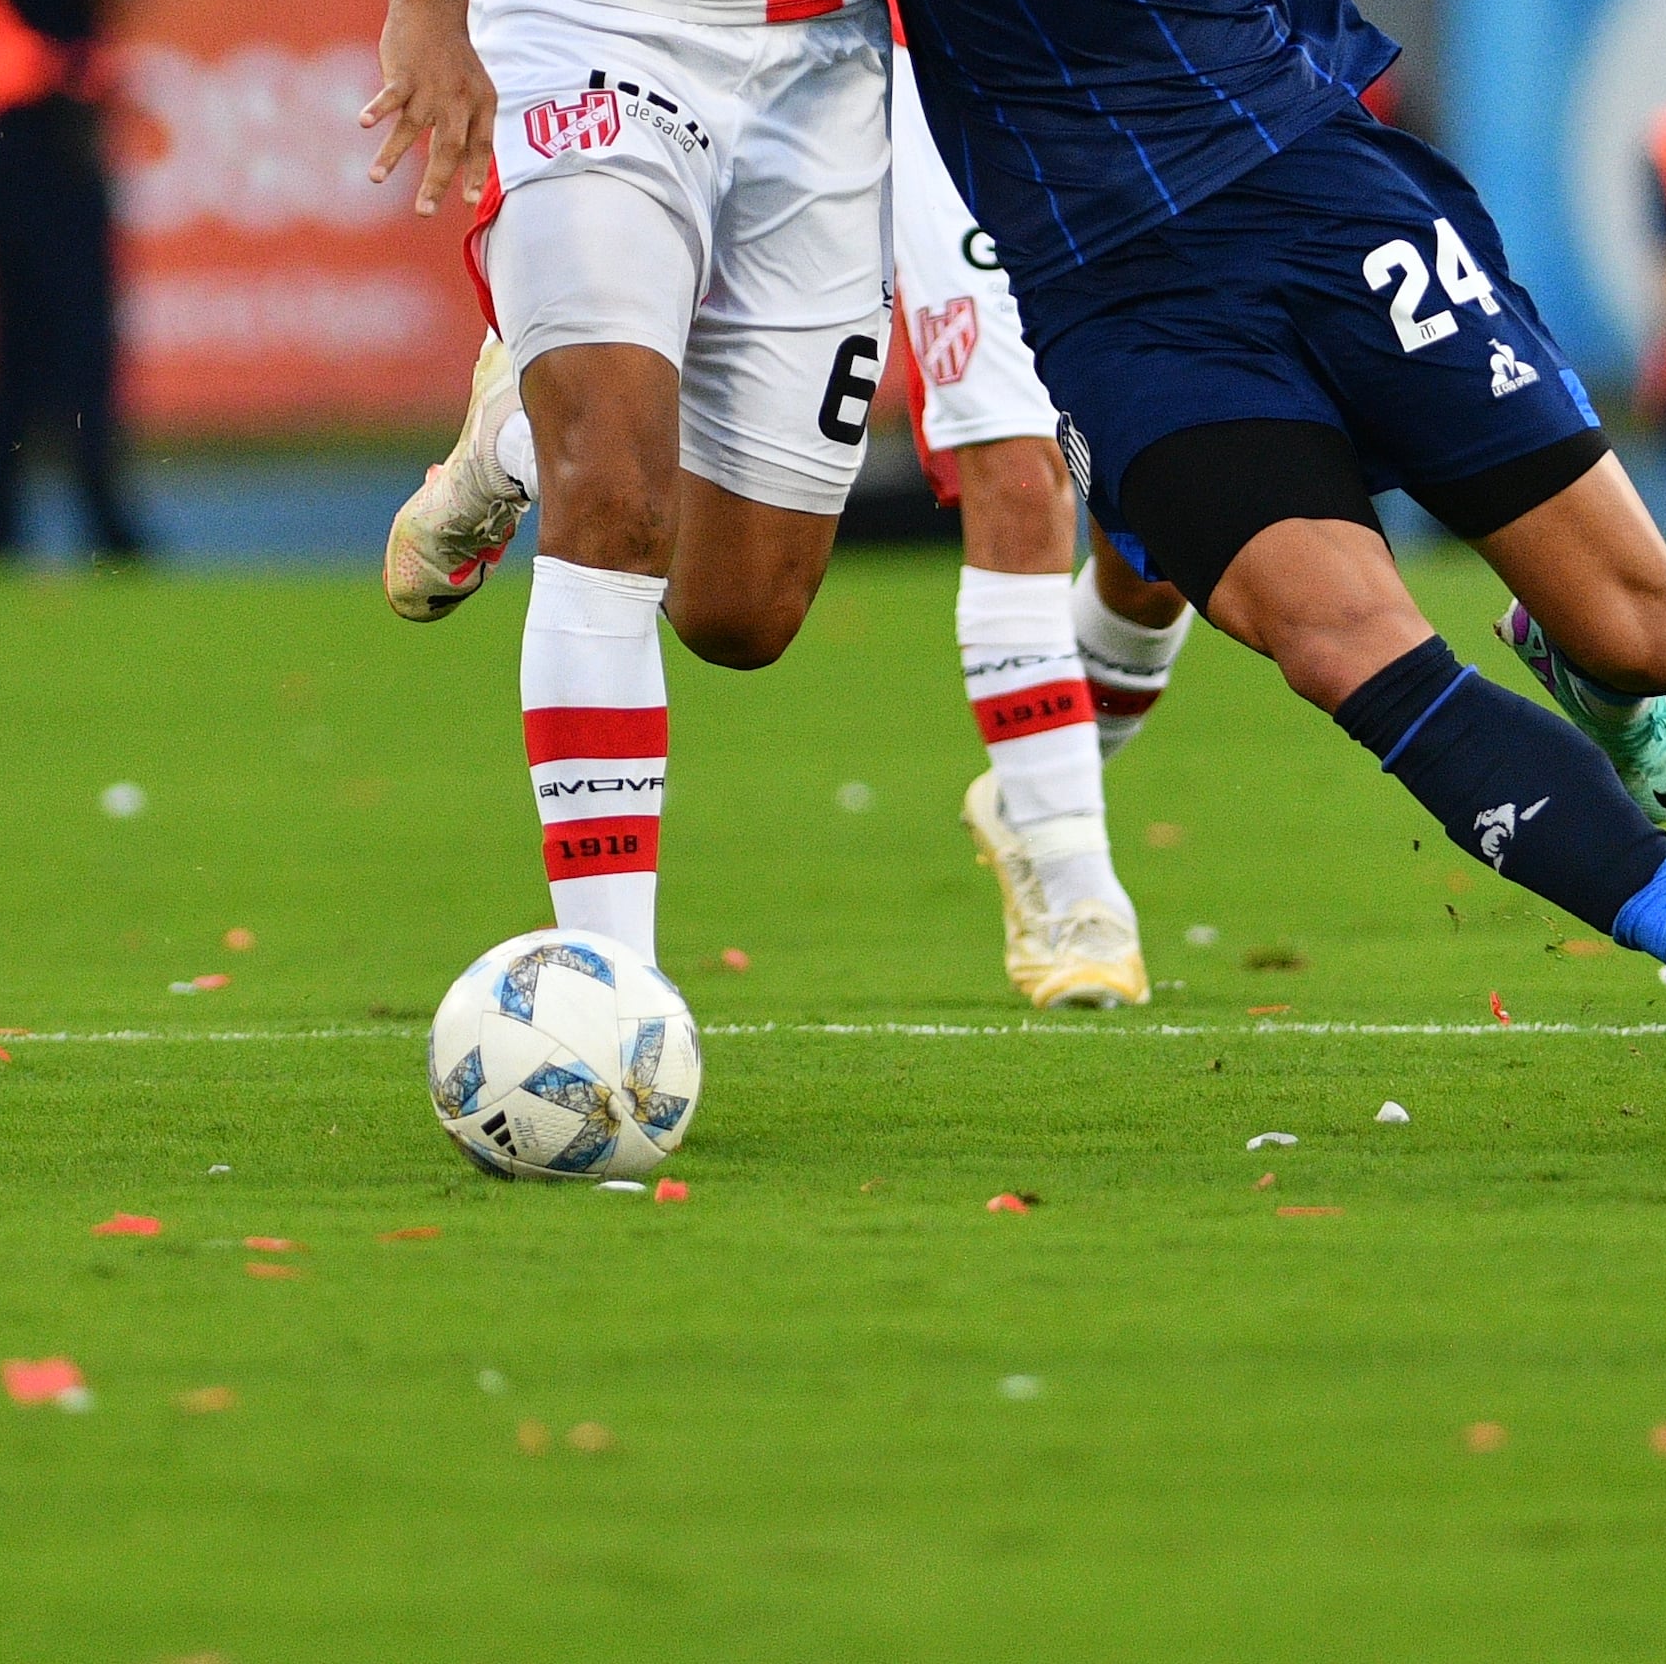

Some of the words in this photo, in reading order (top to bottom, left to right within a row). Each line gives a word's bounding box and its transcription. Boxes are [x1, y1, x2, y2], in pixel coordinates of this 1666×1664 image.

[625, 100, 651, 122] de
[652, 114, 697, 154] salud
[1363, 217, 1501, 353] 24
[539, 777, 665, 798] GIVOVA
[558, 834, 639, 860] 1918
